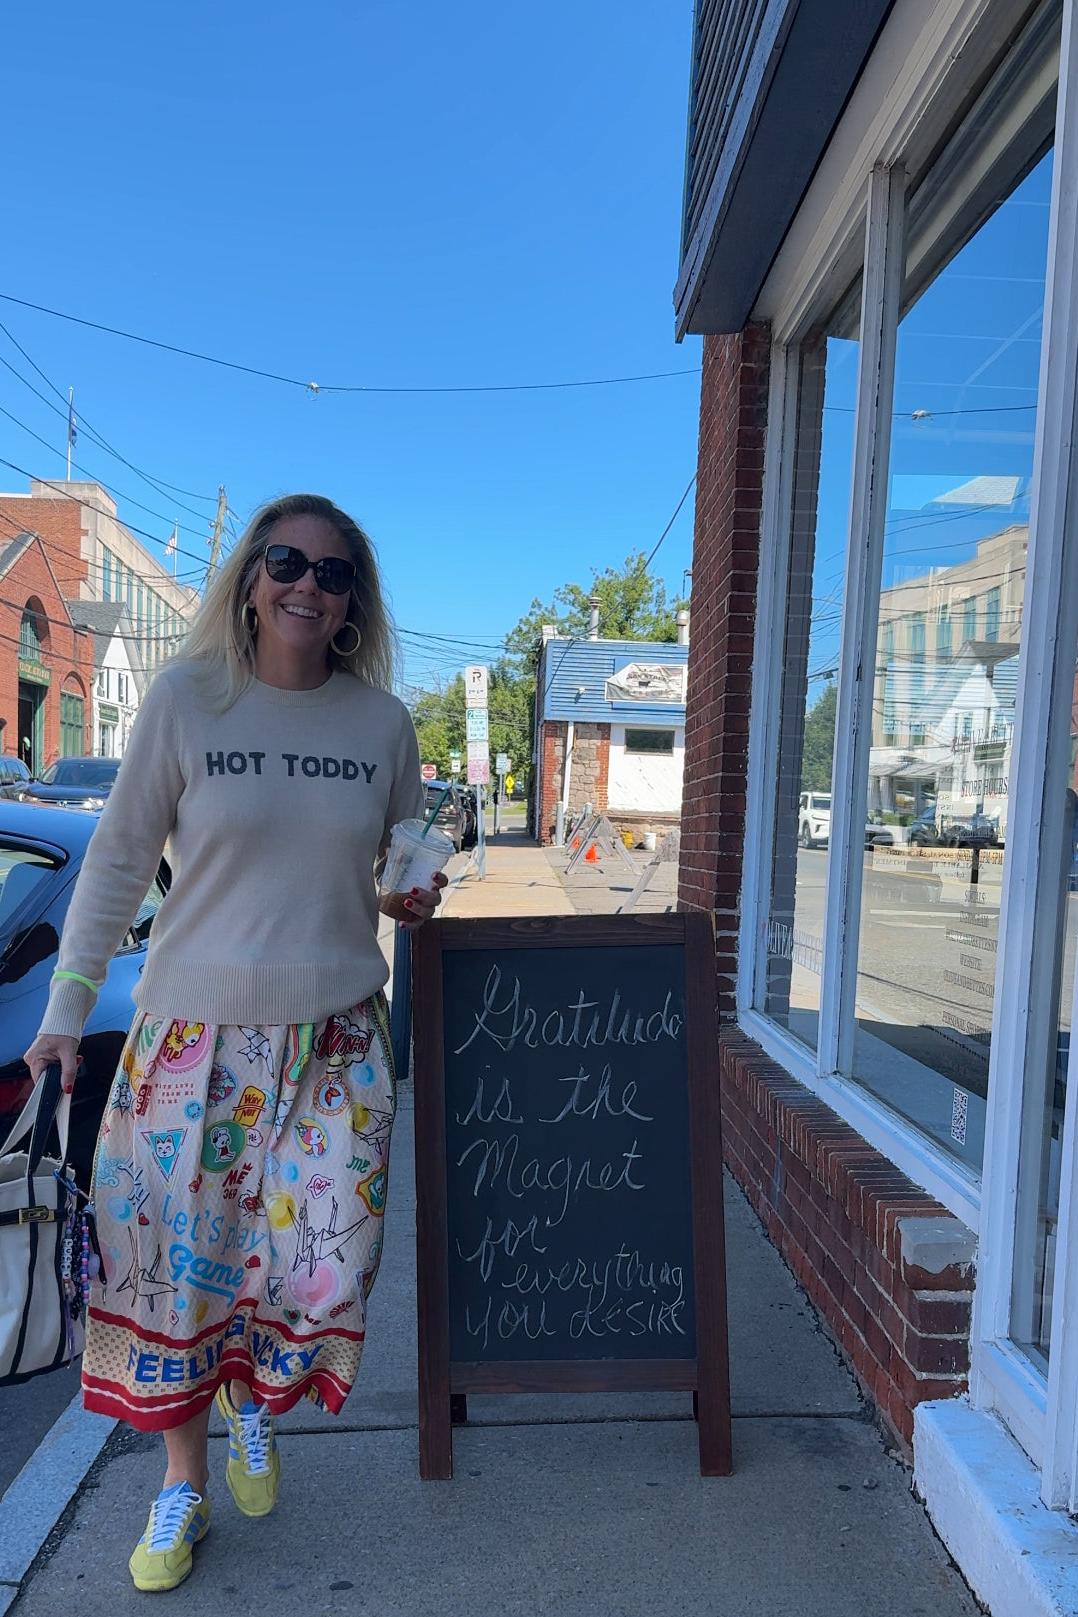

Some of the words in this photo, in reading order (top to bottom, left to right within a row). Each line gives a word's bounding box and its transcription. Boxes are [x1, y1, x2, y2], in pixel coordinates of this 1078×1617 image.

[206, 751, 266, 777] HOT
[282, 753, 378, 785] TODDY
[984, 777, 1008, 796] HOURS
[454, 963, 683, 1054] Gratitude
[457, 1065, 523, 1125] is
[540, 1063, 654, 1122] the
[457, 1135, 645, 1225] Magnet
[457, 1215, 548, 1282] for
[502, 1243, 684, 1310] everything
